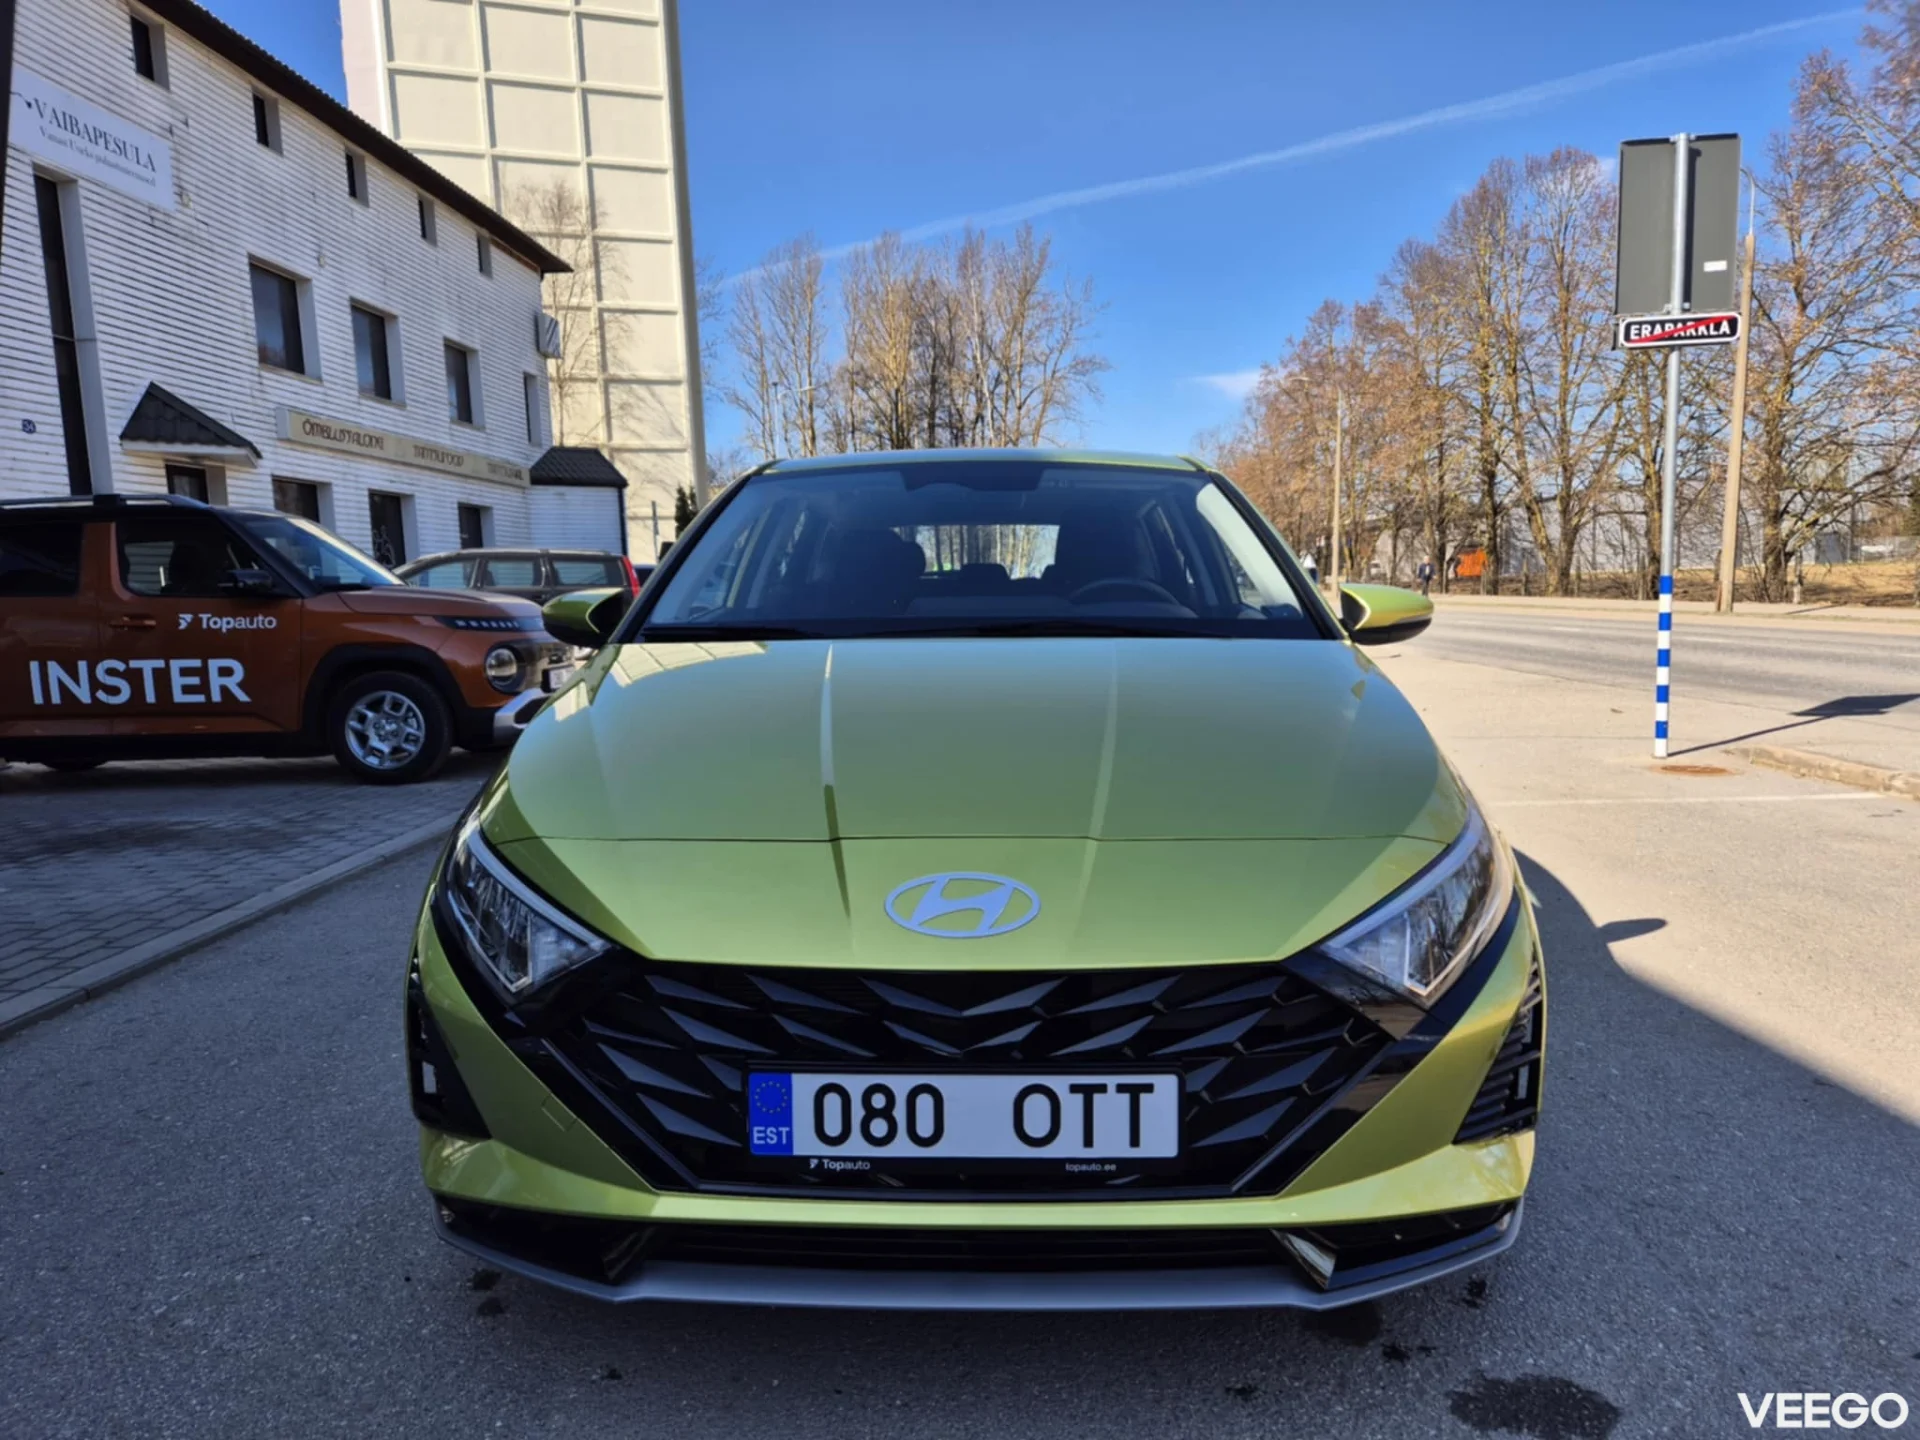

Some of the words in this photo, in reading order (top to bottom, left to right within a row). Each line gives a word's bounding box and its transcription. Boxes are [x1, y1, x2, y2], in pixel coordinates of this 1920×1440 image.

[34, 98, 157, 173] VAIBAPESULA
[1630, 320, 1731, 340] ERAPARKLA
[198, 613, 278, 633] Topauto
[29, 658, 252, 705] INSTER
[813, 1082, 945, 1148] 080
[1013, 1083, 1155, 1148] OTT
[753, 1126, 790, 1145] EST
[821, 1158, 871, 1172] Topauto
[1065, 1162, 1117, 1173] topauto.ee
